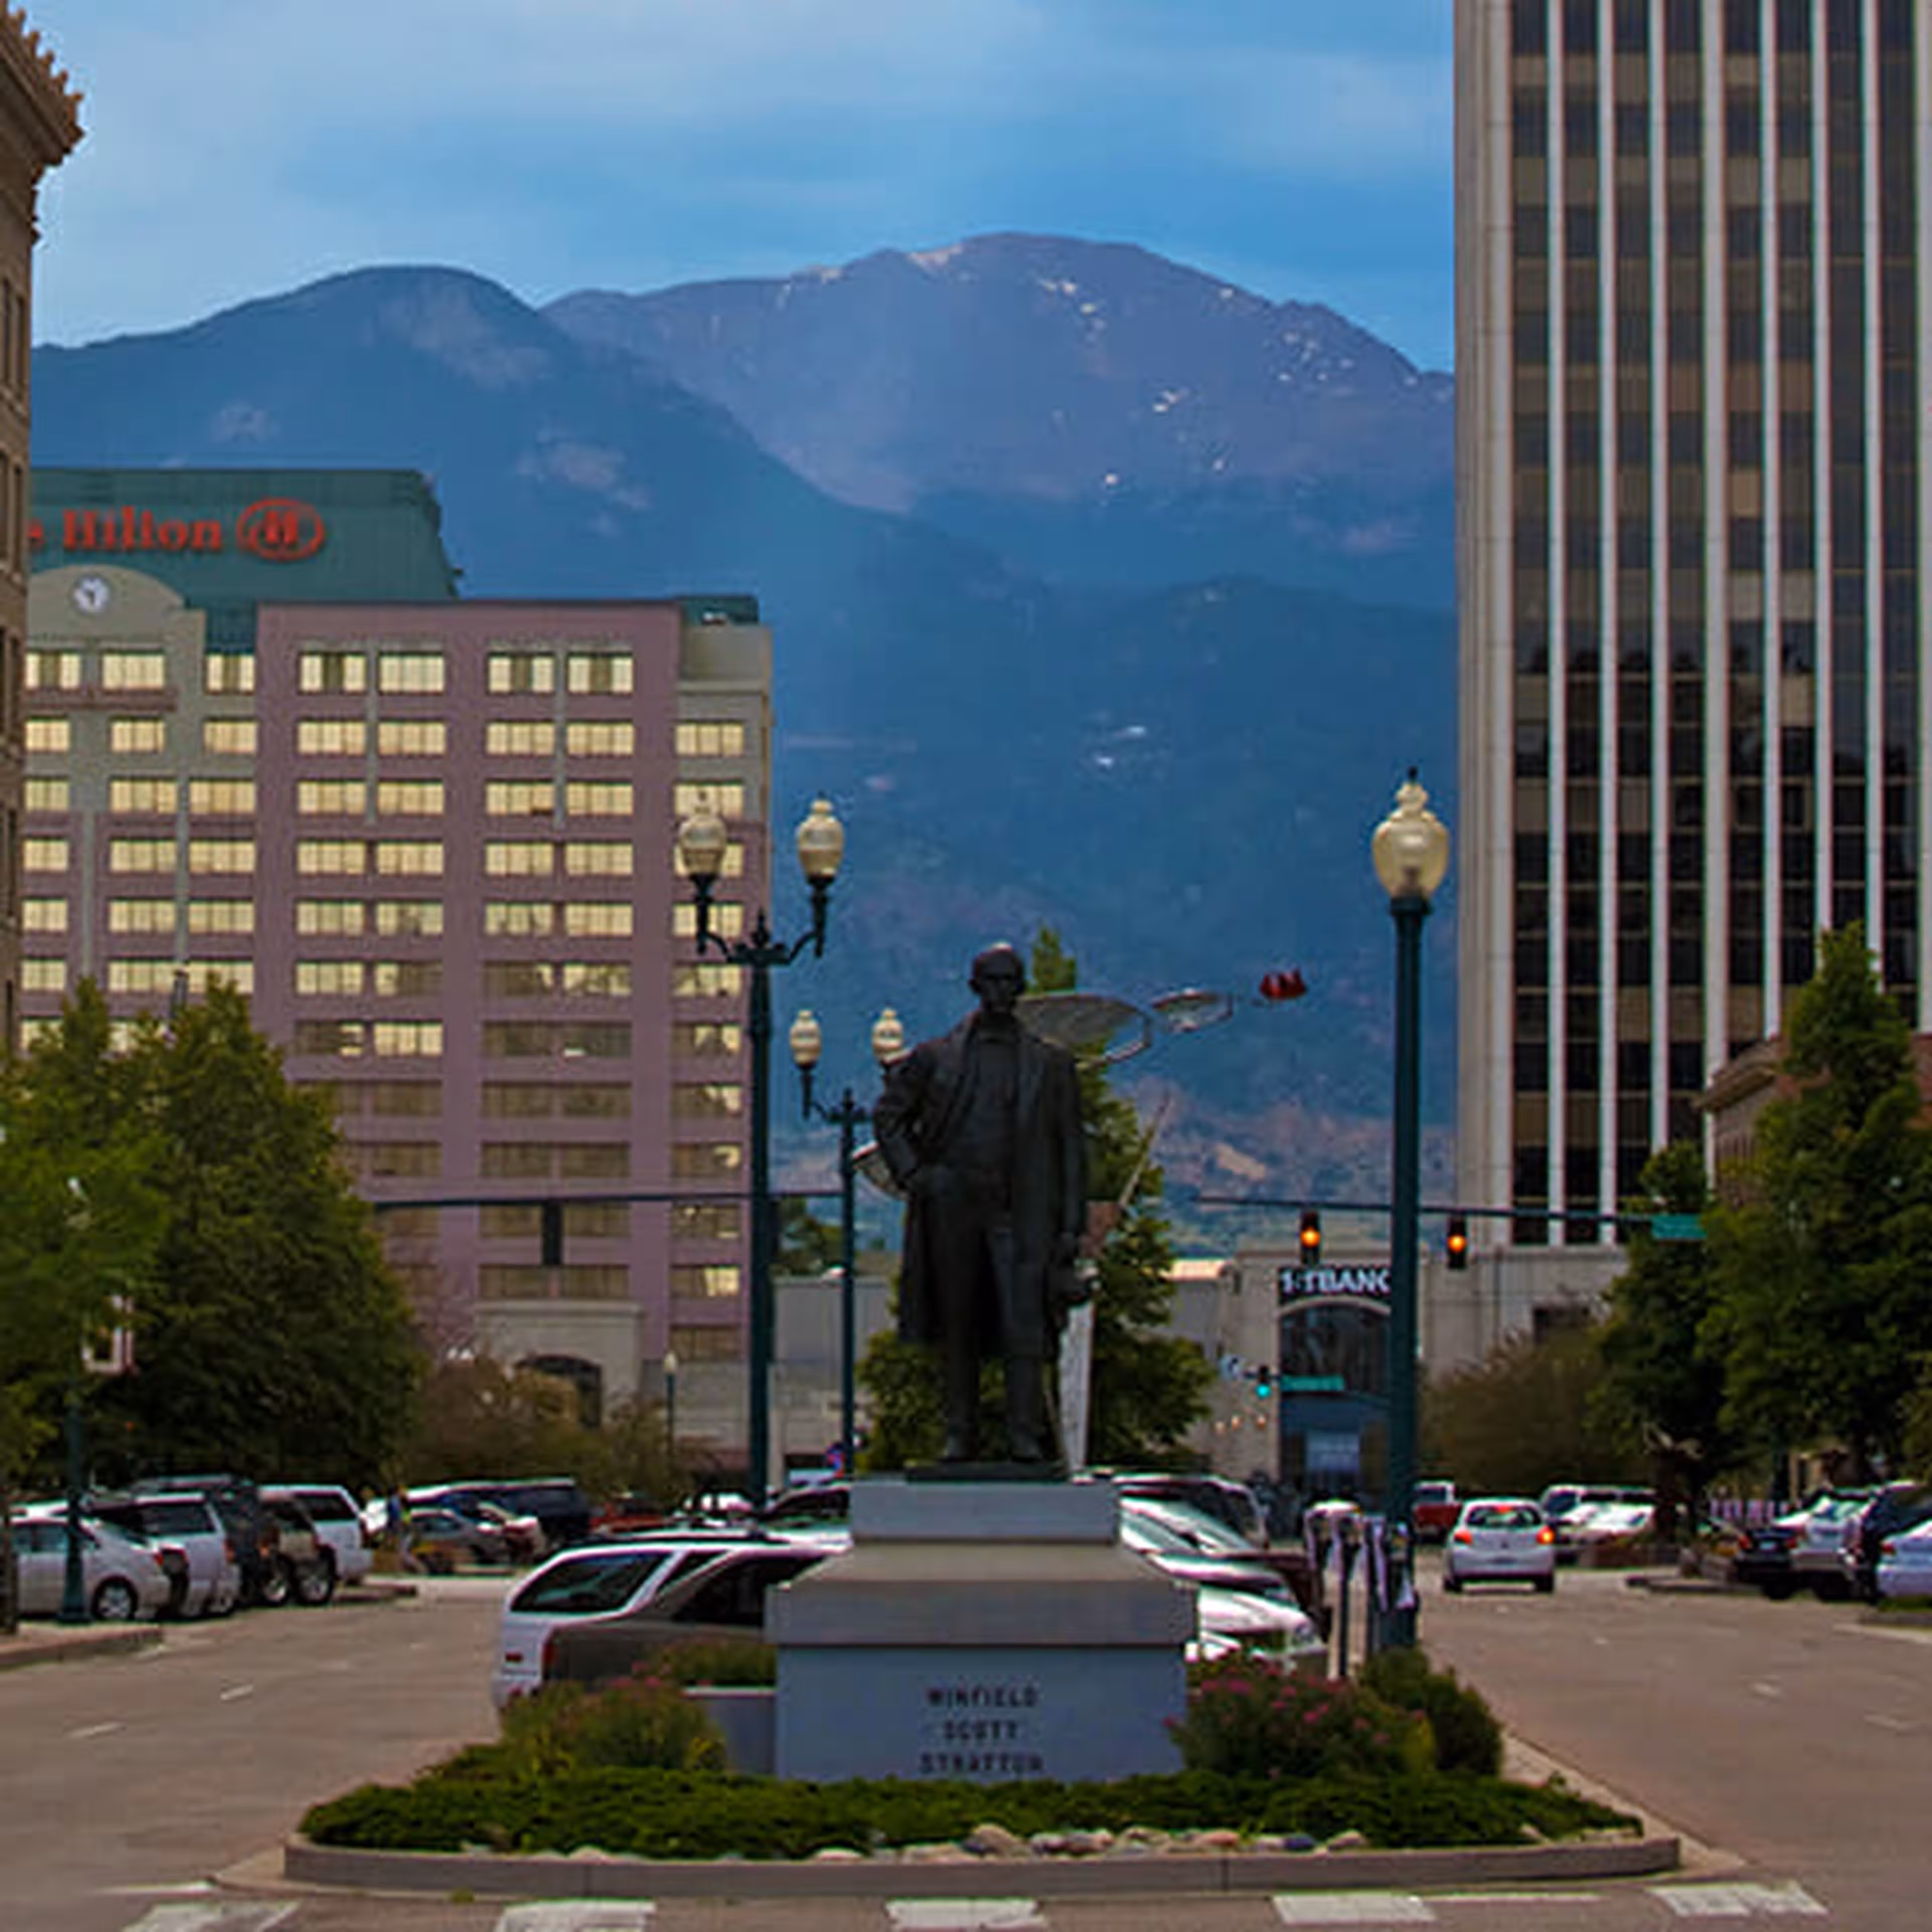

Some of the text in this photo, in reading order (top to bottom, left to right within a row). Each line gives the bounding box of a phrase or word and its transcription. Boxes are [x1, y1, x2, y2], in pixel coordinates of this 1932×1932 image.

[62, 505, 223, 550] Hilton
[926, 1685, 1039, 1708] WINFIELD
[943, 1720, 1017, 1740] SCOTT
